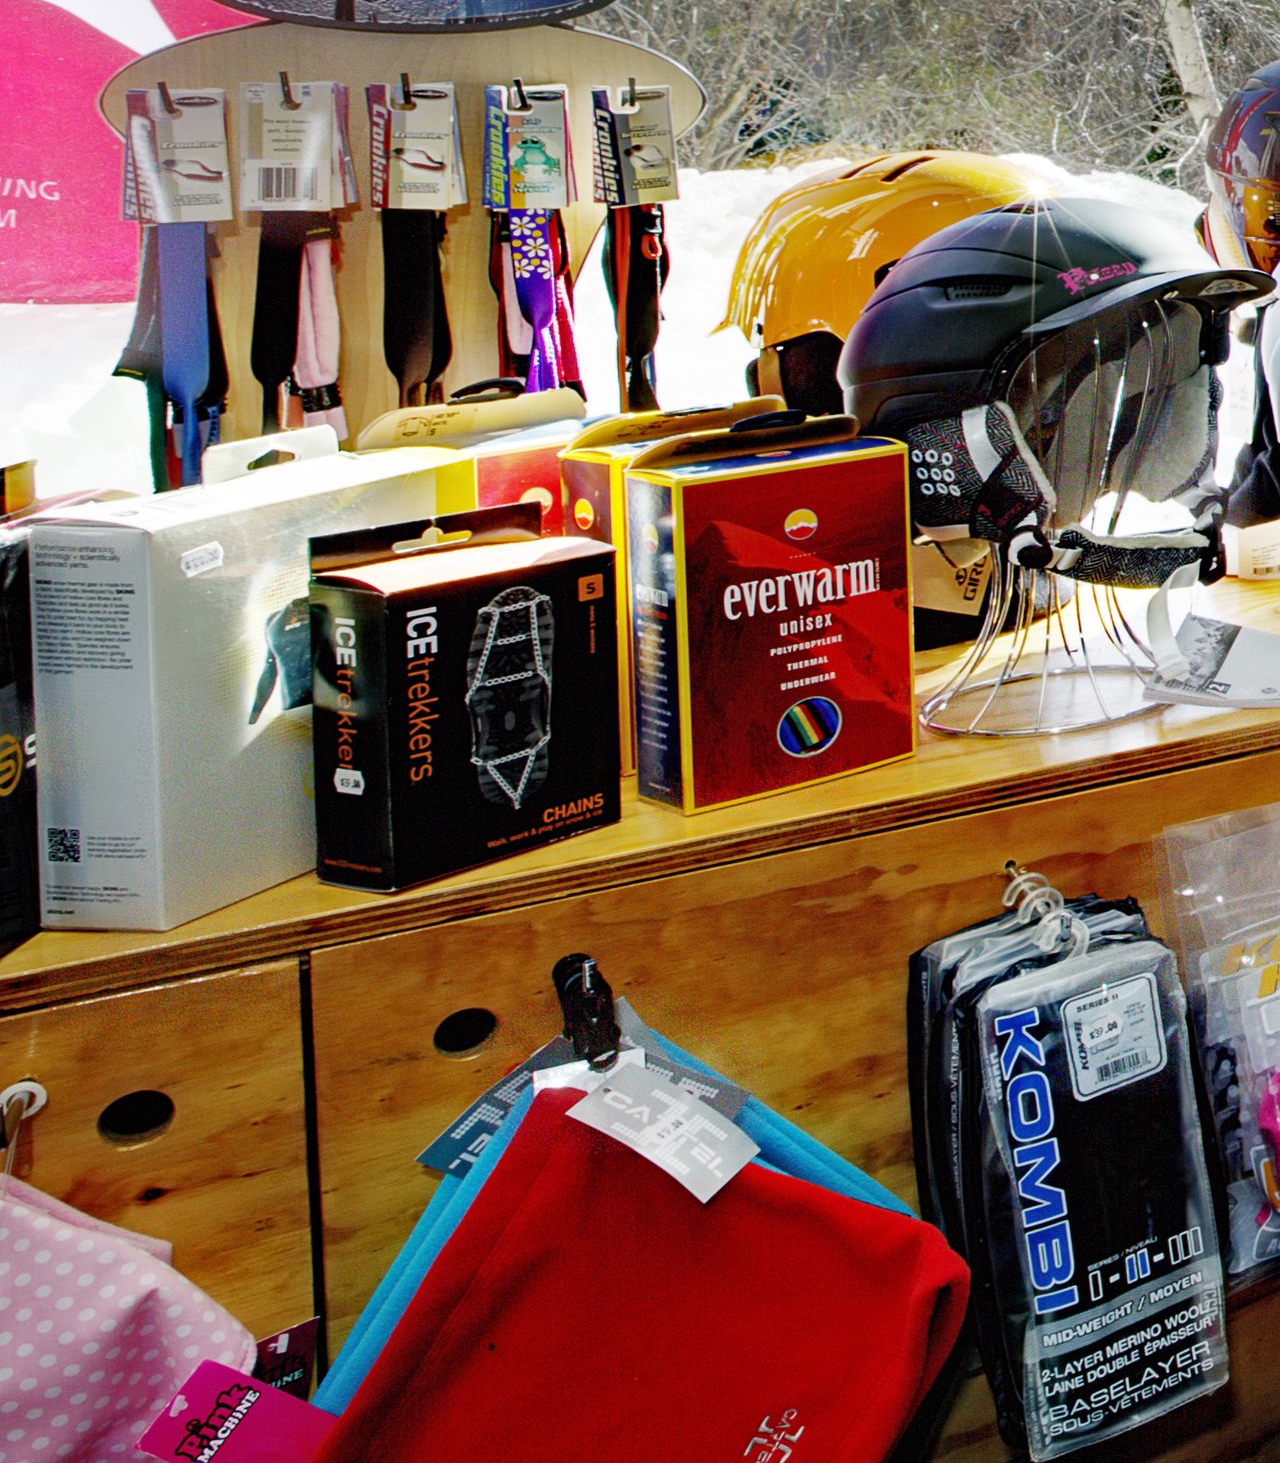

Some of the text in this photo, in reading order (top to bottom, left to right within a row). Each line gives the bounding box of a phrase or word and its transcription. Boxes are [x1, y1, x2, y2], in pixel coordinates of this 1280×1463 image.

[0, 178, 60, 200] ING
[585, 582, 596, 595] S
[723, 558, 876, 622] everwarm
[769, 635, 843, 658] POLYPROPYLENE
[779, 612, 833, 637] unisex
[406, 606, 439, 783] ICEtrekkers
[780, 671, 837, 692] UNDERWEAR
[787, 655, 829, 672] THERMAL
[542, 793, 605, 824] CHAINS
[1076, 997, 1110, 1013] SERIES
[995, 1007, 1080, 1314] KOMBI
[1042, 1300, 1134, 1348] MID-WEIGHT
[1149, 1271, 1204, 1305] MOYEN
[1041, 1302, 1210, 1384] 2-LAYER MERINO WOOL
[1044, 1316, 1214, 1399] LAINE DOUBLE ÉPAISSEUR
[1048, 1340, 1212, 1423] BASELAYER
[1050, 1357, 1216, 1437] SOUS-VÊTEMENTS
[196, 1389, 261, 1463] MACHINE
